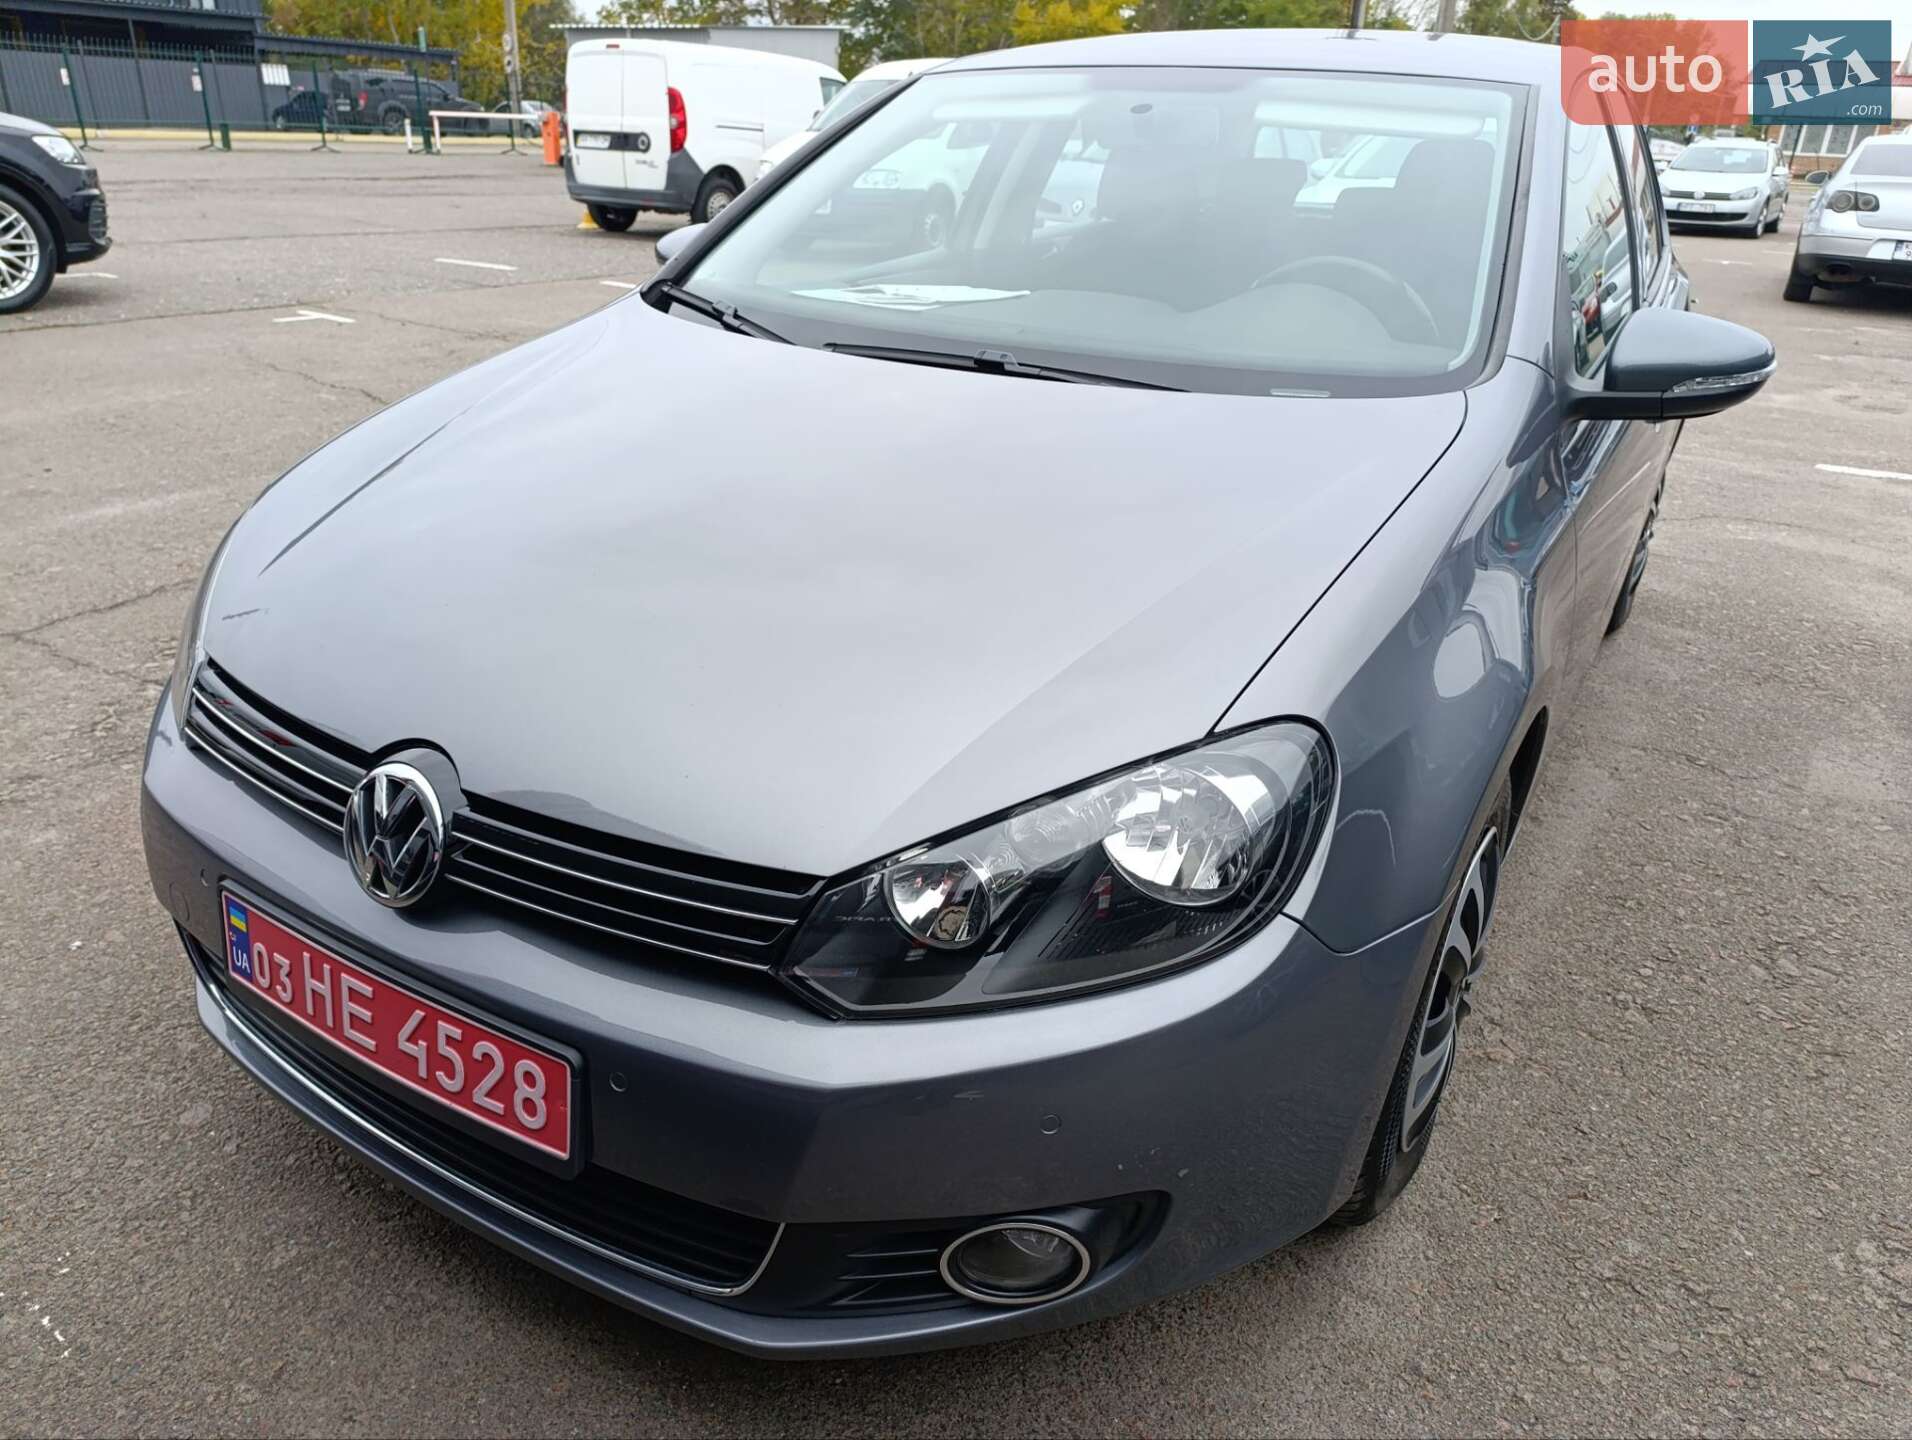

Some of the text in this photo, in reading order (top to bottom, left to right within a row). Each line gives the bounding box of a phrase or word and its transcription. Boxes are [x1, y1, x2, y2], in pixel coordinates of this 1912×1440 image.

[233, 946, 251, 974] UA
[253, 942, 548, 1131] 03 HE 4528
